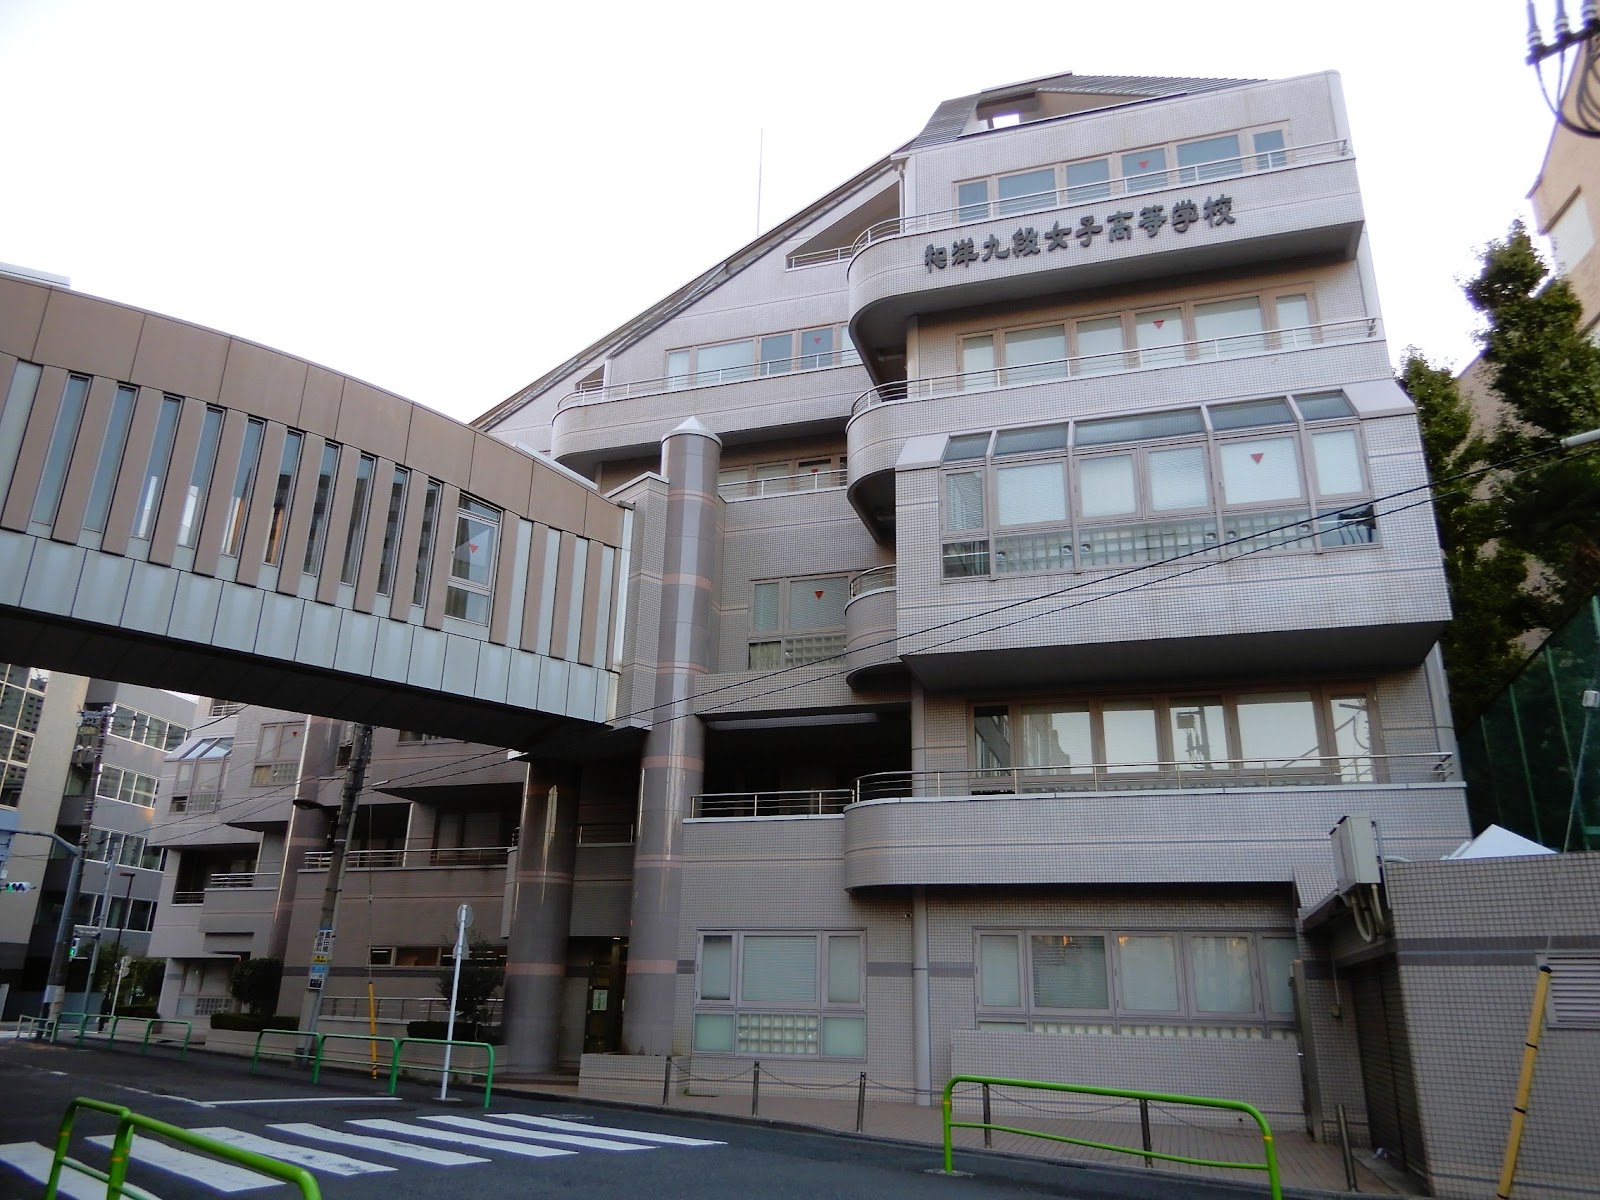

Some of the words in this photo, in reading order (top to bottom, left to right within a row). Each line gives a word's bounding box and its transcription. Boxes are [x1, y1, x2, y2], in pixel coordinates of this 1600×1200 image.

[924, 193, 1236, 273] 和洋九段女子高等学校
